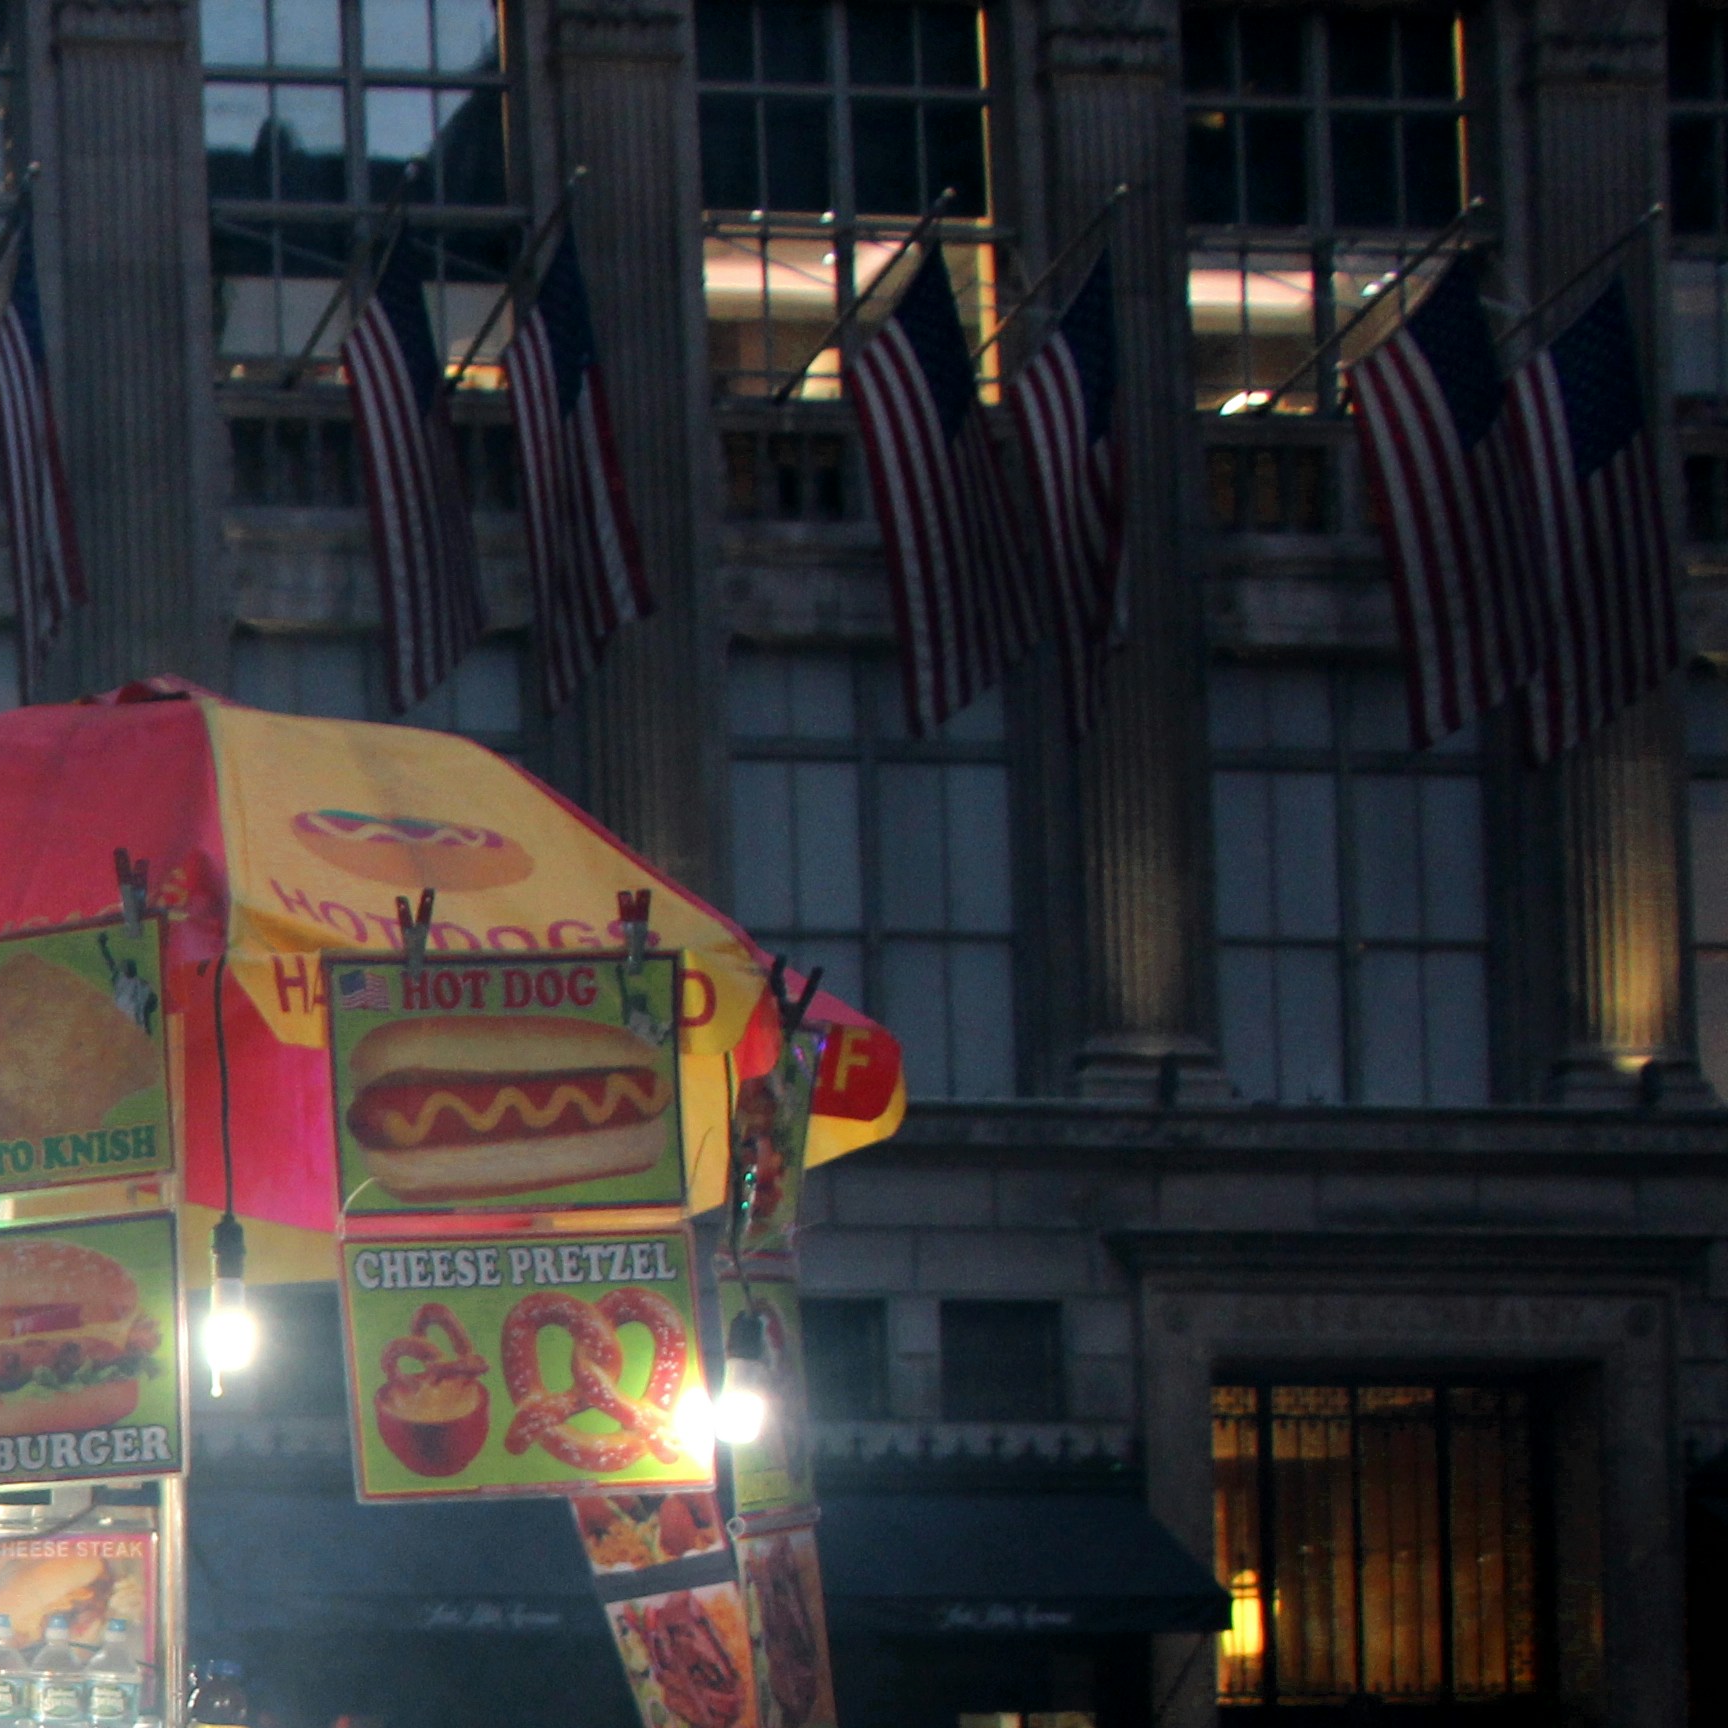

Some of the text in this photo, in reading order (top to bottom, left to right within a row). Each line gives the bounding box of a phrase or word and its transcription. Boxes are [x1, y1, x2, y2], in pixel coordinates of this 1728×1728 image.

[270, 878, 406, 949] HOT
[400, 966, 598, 1011] HOT DOG
[42, 1124, 159, 1169] KNISH
[354, 1242, 677, 1290] CHEESE PRETZEL
[75, 1539, 144, 1558] STEAK
